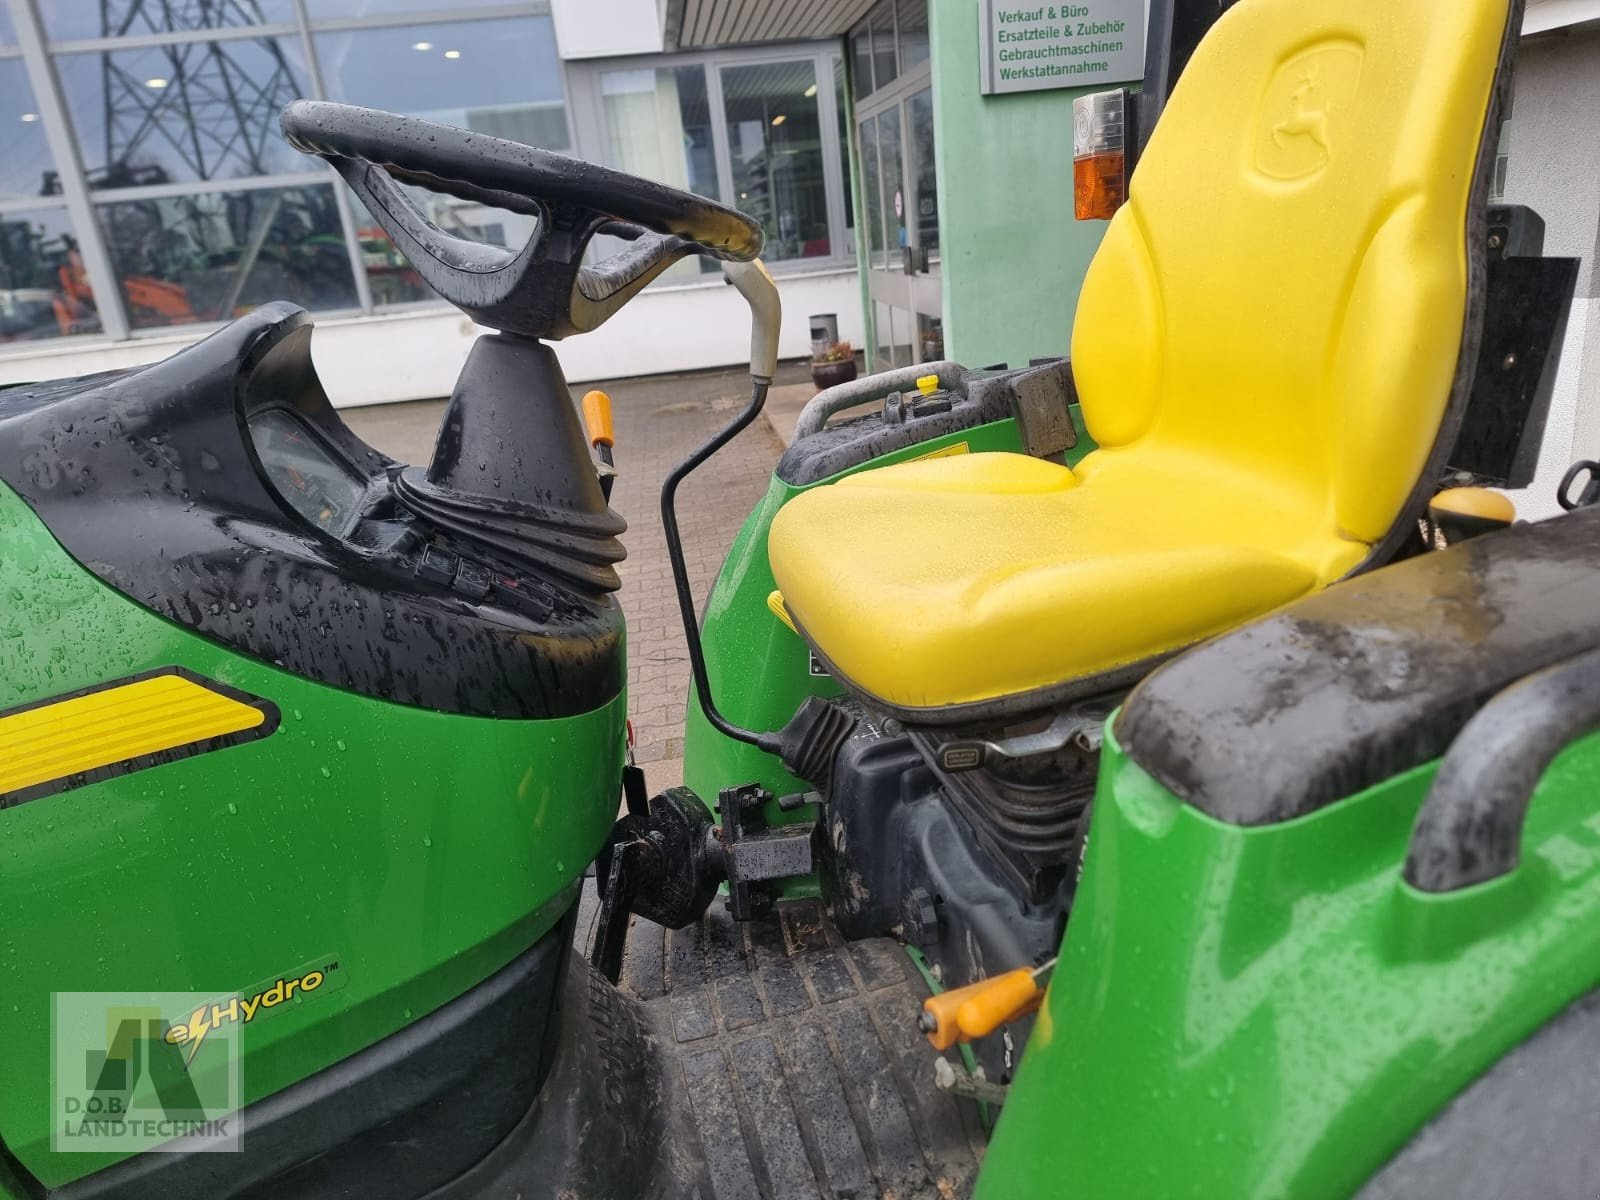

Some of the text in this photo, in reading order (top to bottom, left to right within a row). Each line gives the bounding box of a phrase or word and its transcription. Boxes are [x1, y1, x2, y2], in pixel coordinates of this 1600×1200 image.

[998, 5, 1089, 23] Verkauf & Büro
[998, 20, 1126, 43] Ersatzteile & Zubehör
[999, 40, 1123, 62] Gebrauchtmaschinen
[1000, 60, 1109, 80] Werkstattannahme
